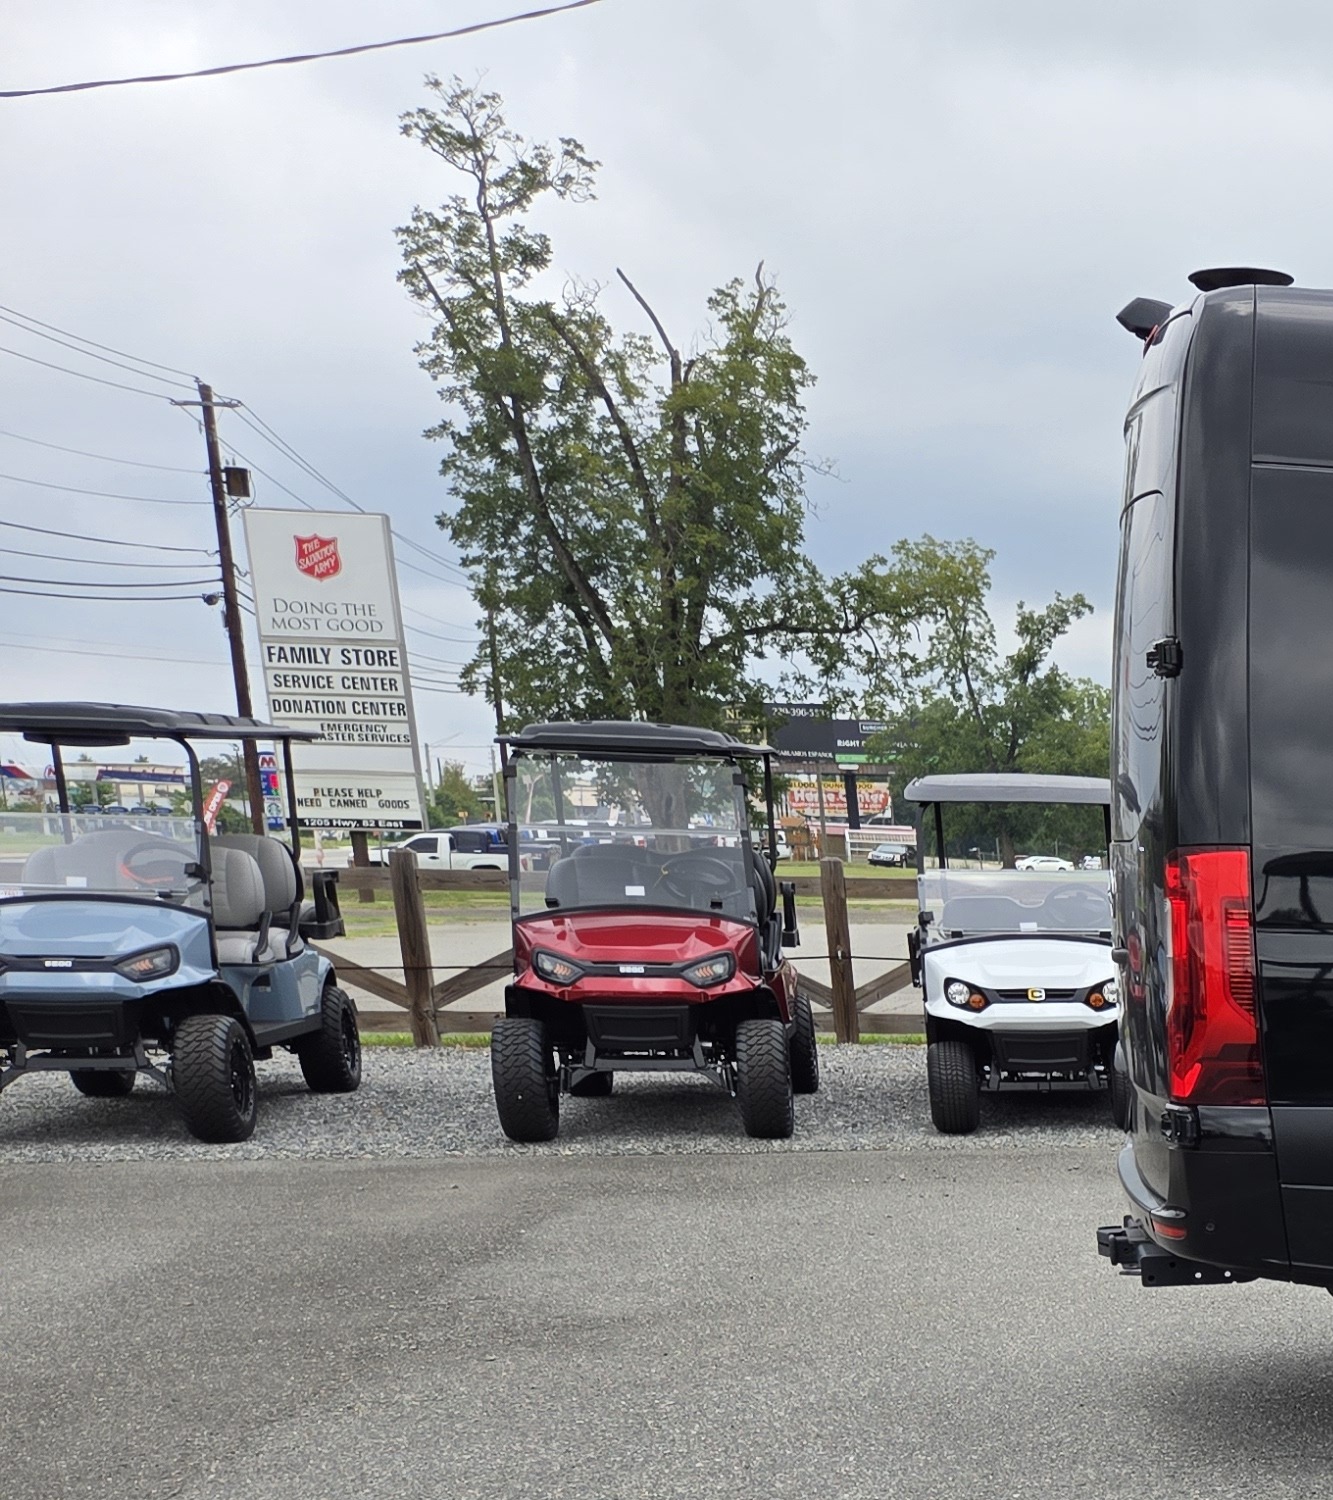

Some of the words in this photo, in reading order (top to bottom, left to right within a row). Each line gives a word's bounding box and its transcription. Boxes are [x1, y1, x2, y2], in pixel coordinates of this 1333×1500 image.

[303, 539, 320, 554] THE
[314, 555, 336, 576] ARMY
[273, 598, 338, 615] DOING
[342, 603, 377, 616] THE
[271, 617, 321, 631] MOST
[327, 618, 383, 633] GOOD
[267, 645, 331, 665] FAMILY
[341, 648, 399, 667] STORE
[273, 673, 335, 690] SERVICE
[341, 676, 399, 692] CENTER
[272, 698, 347, 715] DONATION
[352, 700, 407, 717] CENTER
[320, 722, 388, 733] EMERGENCY
[318, 732, 356, 742] ASTER
[358, 733, 411, 743] SERVICES
[313, 787, 354, 798] PLEASE
[357, 788, 383, 798] HELP
[297, 797, 322, 807] NEED
[329, 798, 368, 808] CANNED
[378, 799, 410, 809] GOODS
[332, 819, 360, 828] Hwy.
[378, 820, 404, 828] East
